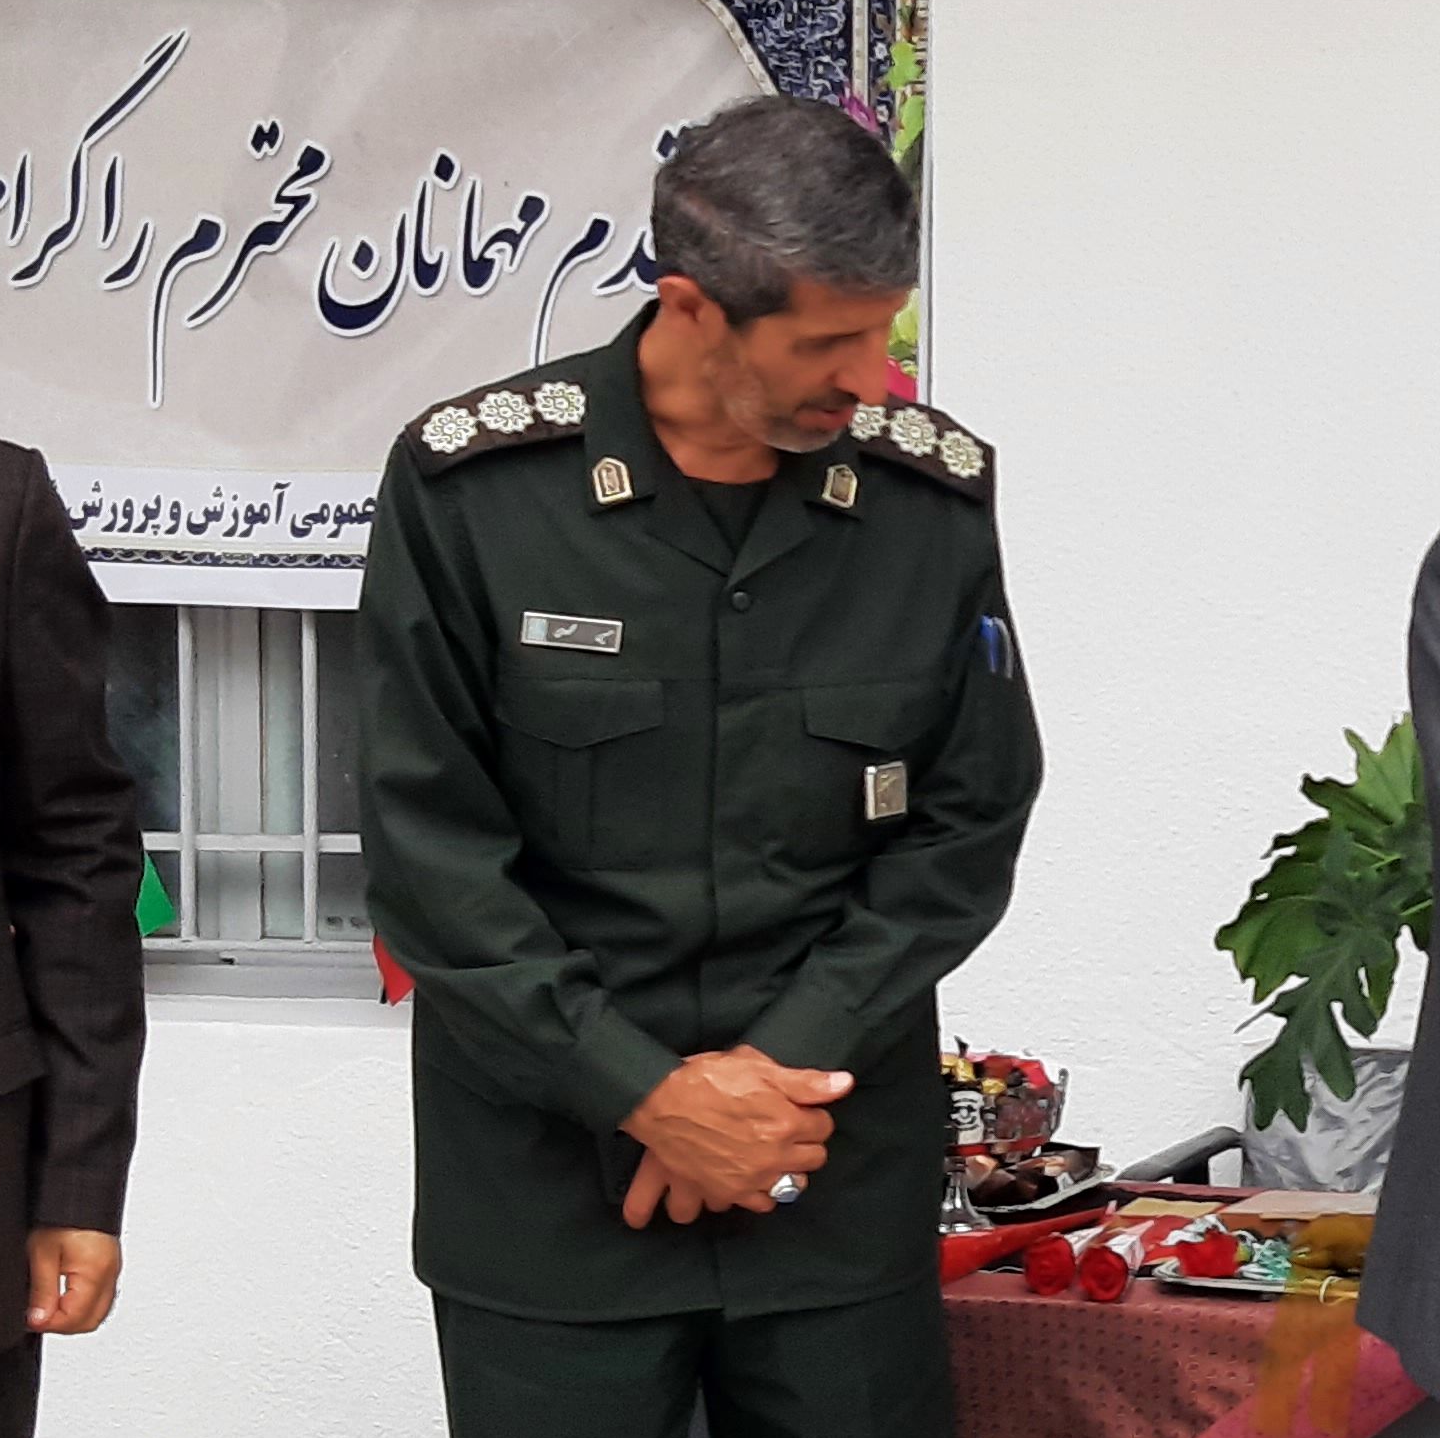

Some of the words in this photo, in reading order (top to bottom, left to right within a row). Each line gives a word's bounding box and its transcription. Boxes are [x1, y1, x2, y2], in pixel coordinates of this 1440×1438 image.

[102, 156, 151, 286] را
[152, 119, 326, 404] محترم
[316, 153, 548, 331] مهمانان
[67, 480, 162, 537] پرورش
[164, 499, 182, 536] و
[187, 481, 291, 538] آموزش
